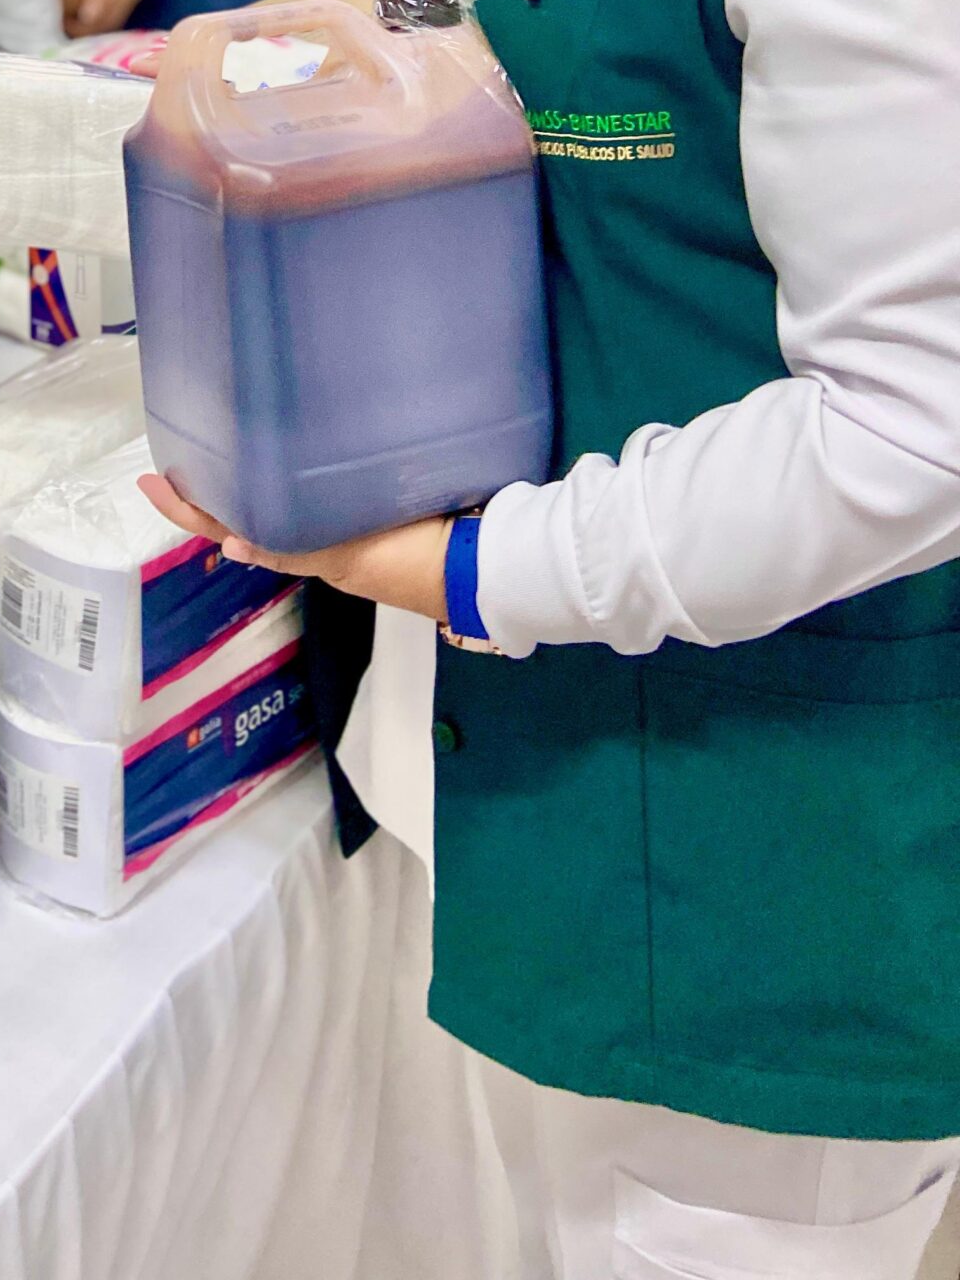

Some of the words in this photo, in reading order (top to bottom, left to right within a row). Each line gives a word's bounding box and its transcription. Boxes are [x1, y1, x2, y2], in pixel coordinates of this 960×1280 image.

[566, 141, 616, 161] PÚBLICOS
[617, 145, 636, 161] DE
[636, 143, 675, 160] SALUD
[234, 688, 285, 748] gasa
